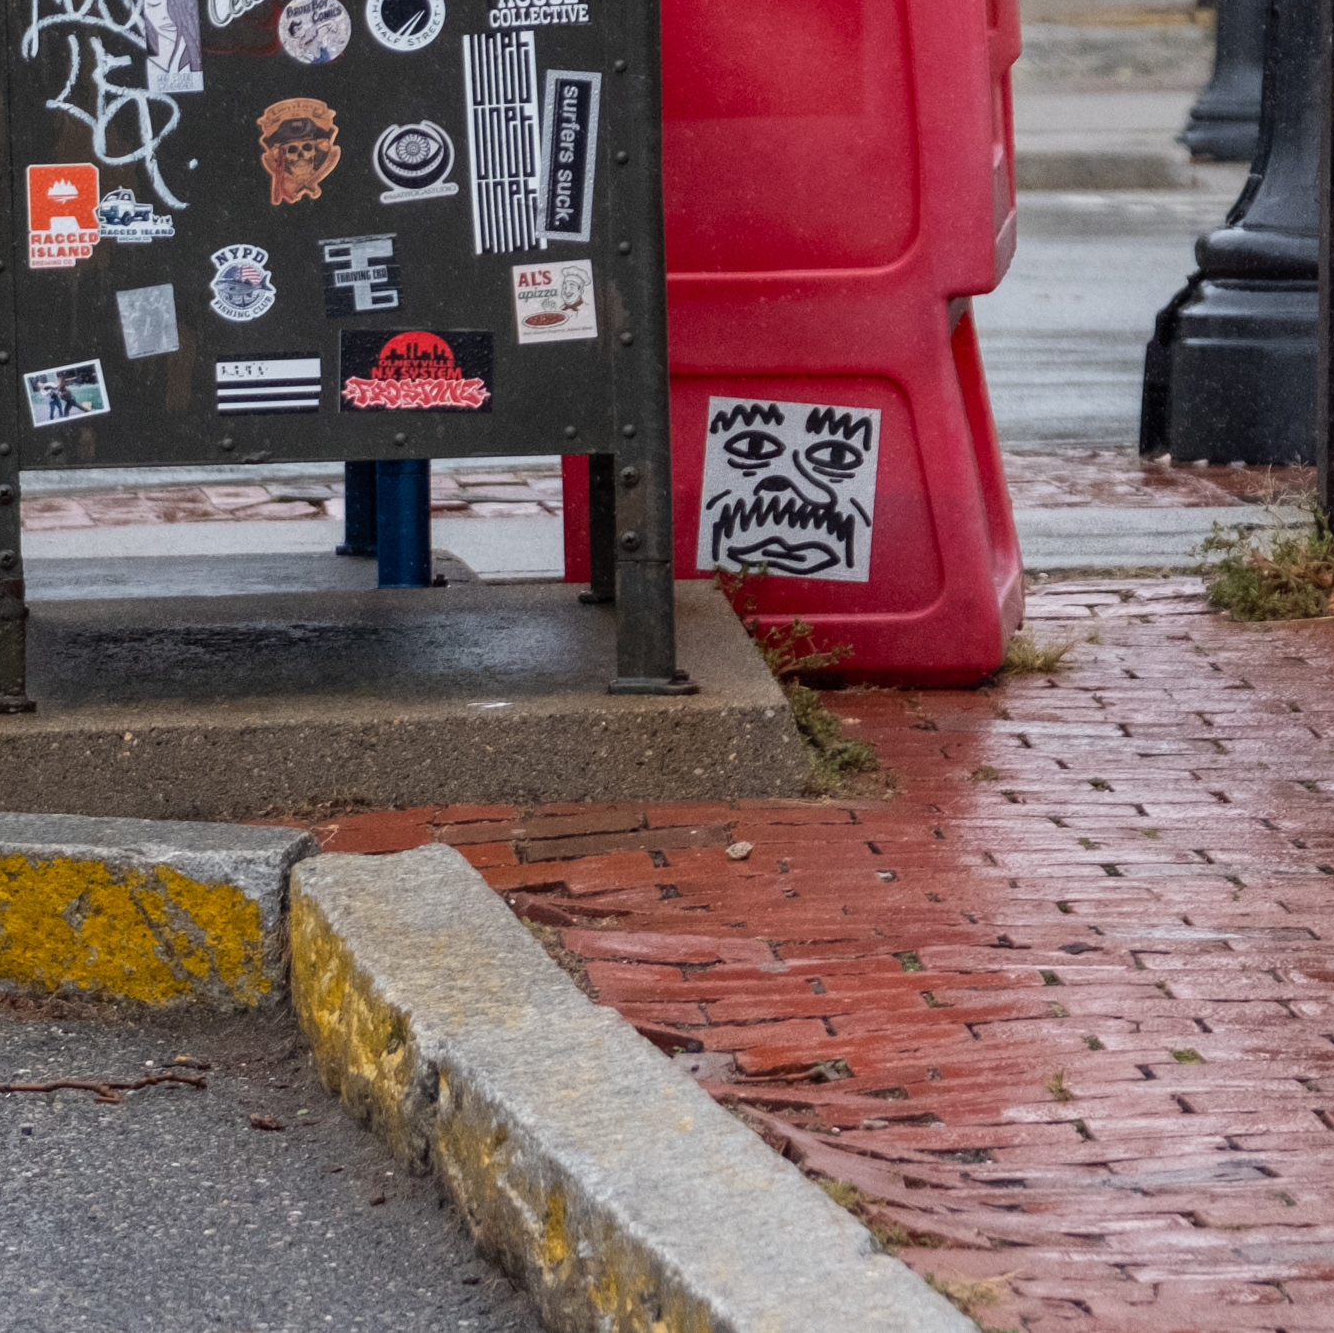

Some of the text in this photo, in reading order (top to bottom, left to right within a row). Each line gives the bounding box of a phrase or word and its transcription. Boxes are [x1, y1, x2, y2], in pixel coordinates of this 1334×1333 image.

[312, 6, 342, 24] COMICS
[489, 4, 590, 28] COLLECTIVE
[374, 11, 441, 46] HALF STREET
[553, 84, 581, 226] surfers suck.
[31, 232, 99, 245] RAGGED
[31, 246, 92, 258] ISLAND
[215, 247, 265, 266] NYPD
[336, 271, 371, 283] THRIVING
[518, 270, 553, 288] AL'S
[518, 287, 558, 303] apizza
[214, 295, 273, 318] FISHING CLUB
[378, 359, 455, 367] OLNEYVILLE
[371, 367, 463, 379] N.Y. SYSTEM
